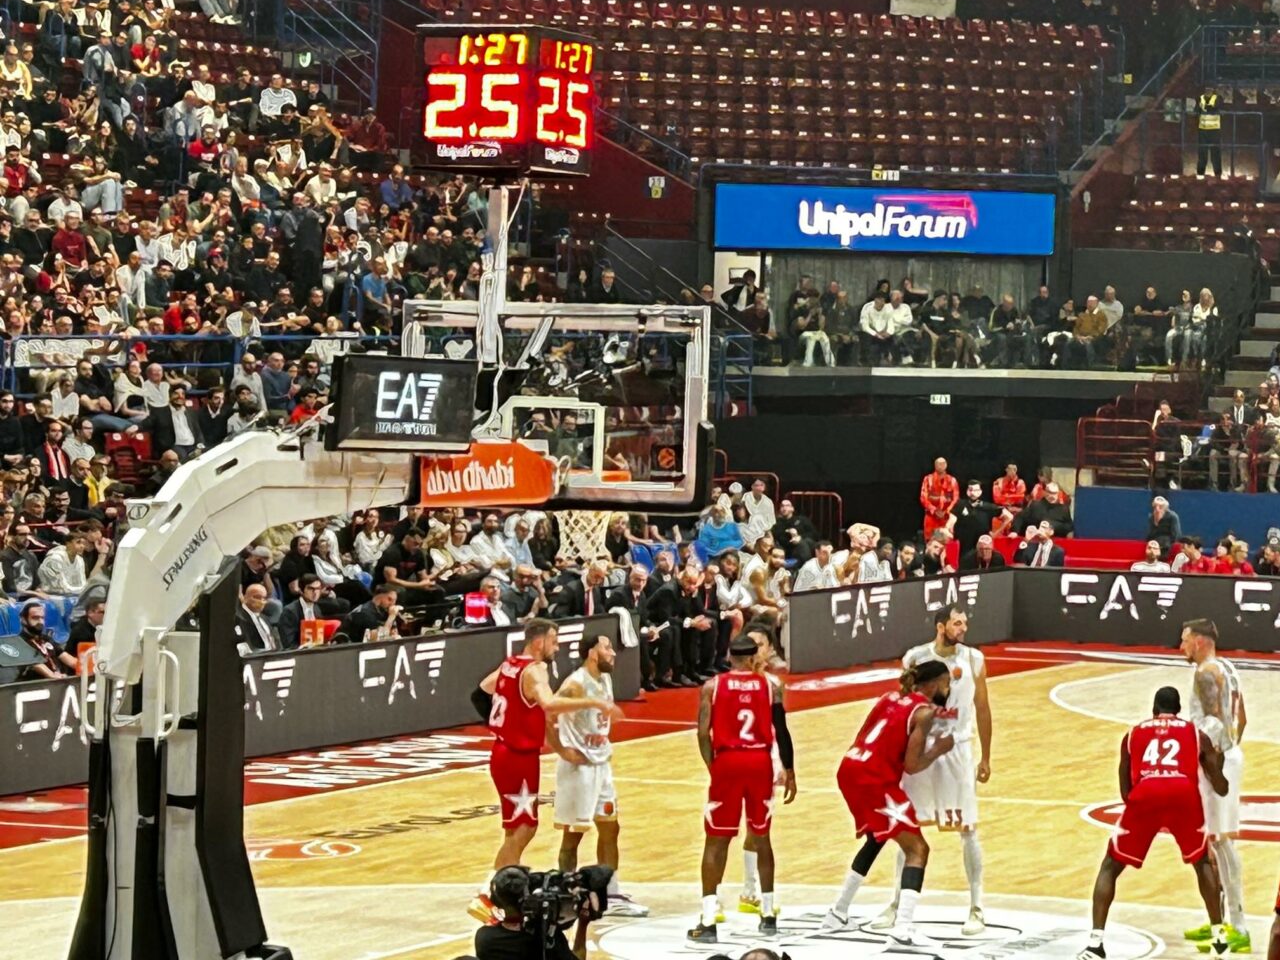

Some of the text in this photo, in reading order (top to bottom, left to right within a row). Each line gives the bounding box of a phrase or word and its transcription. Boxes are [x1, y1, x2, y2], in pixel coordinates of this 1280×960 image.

[459, 33, 528, 65] 1:27
[555, 41, 593, 74] 1:27
[424, 73, 520, 138] 2.5
[798, 199, 967, 247] UnipolForum
[375, 371, 444, 420] EA7
[737, 708, 755, 741] 2
[1142, 738, 1181, 767] 42
